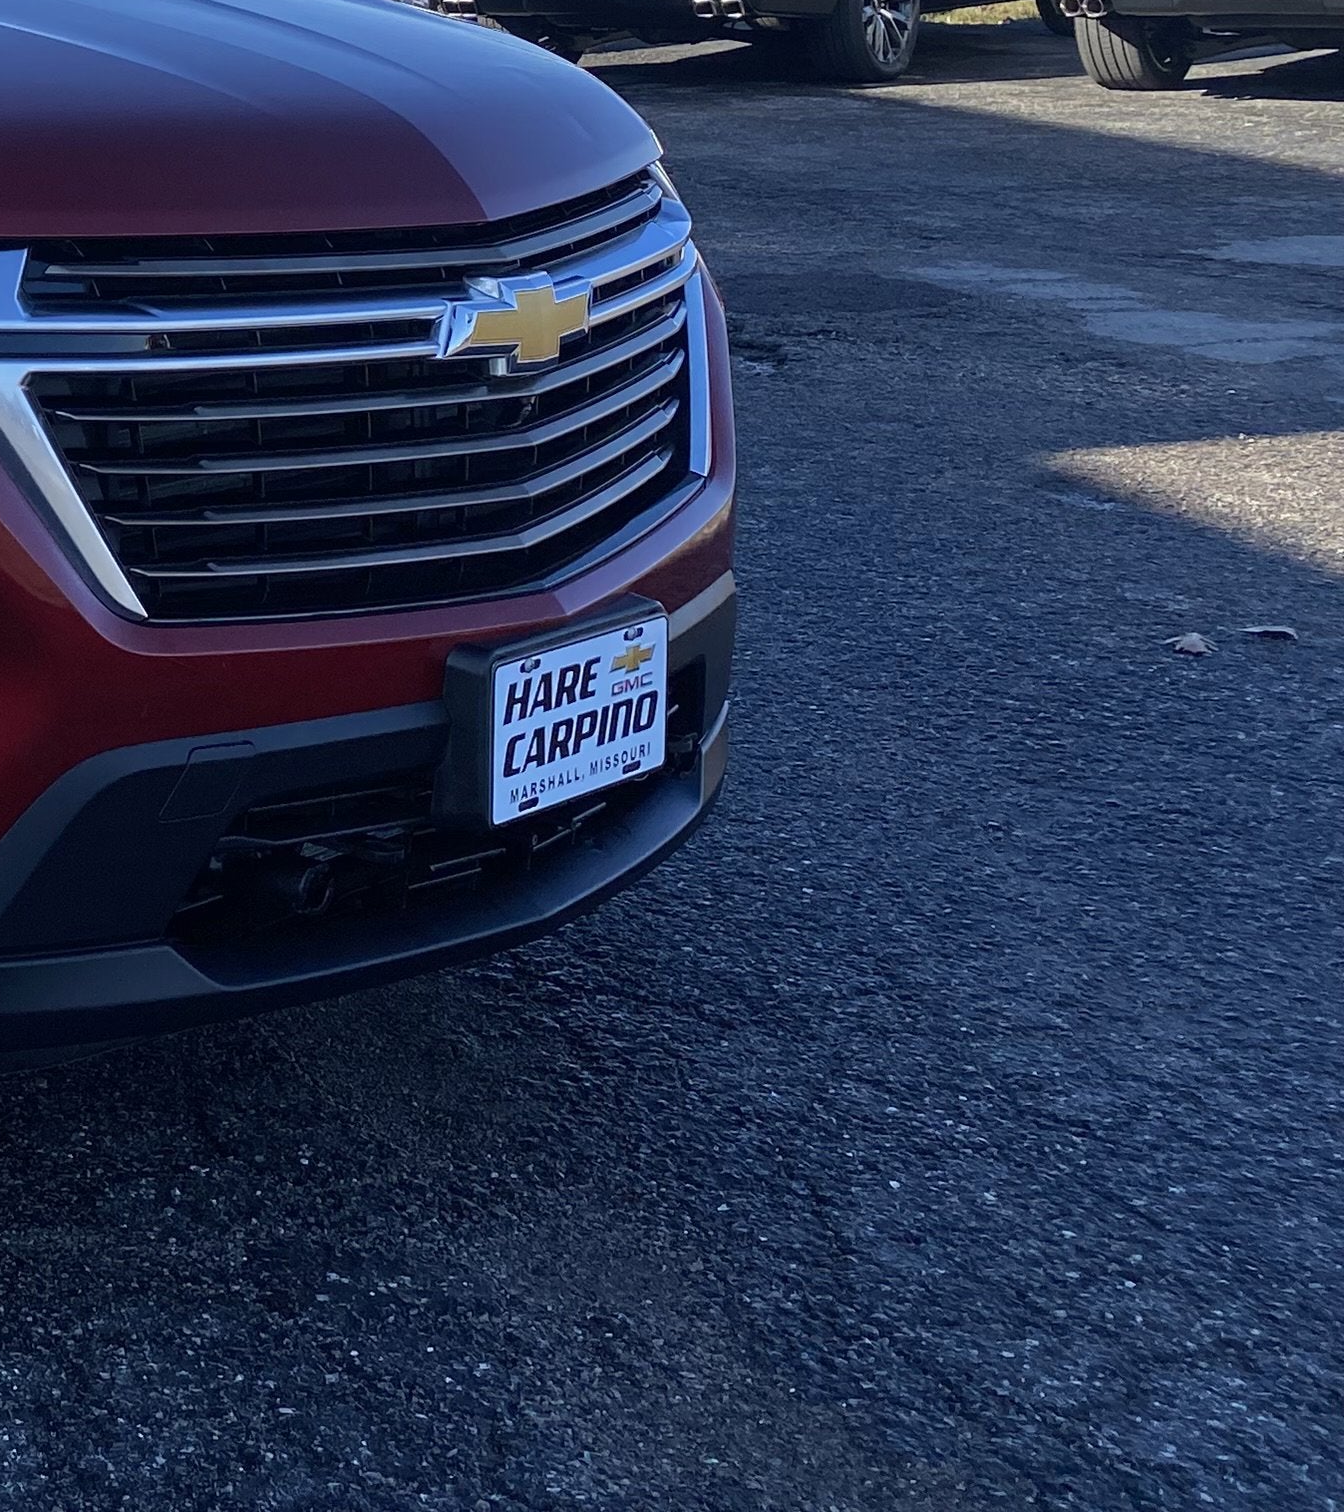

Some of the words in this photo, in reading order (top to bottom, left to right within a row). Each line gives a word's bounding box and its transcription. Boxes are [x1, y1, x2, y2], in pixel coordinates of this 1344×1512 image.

[502, 656, 601, 726] HARE
[611, 671, 654, 697] GMC
[502, 690, 658, 778] CARPINO
[510, 767, 585, 804] MARSHALL,
[589, 741, 651, 777] MISSOURI
